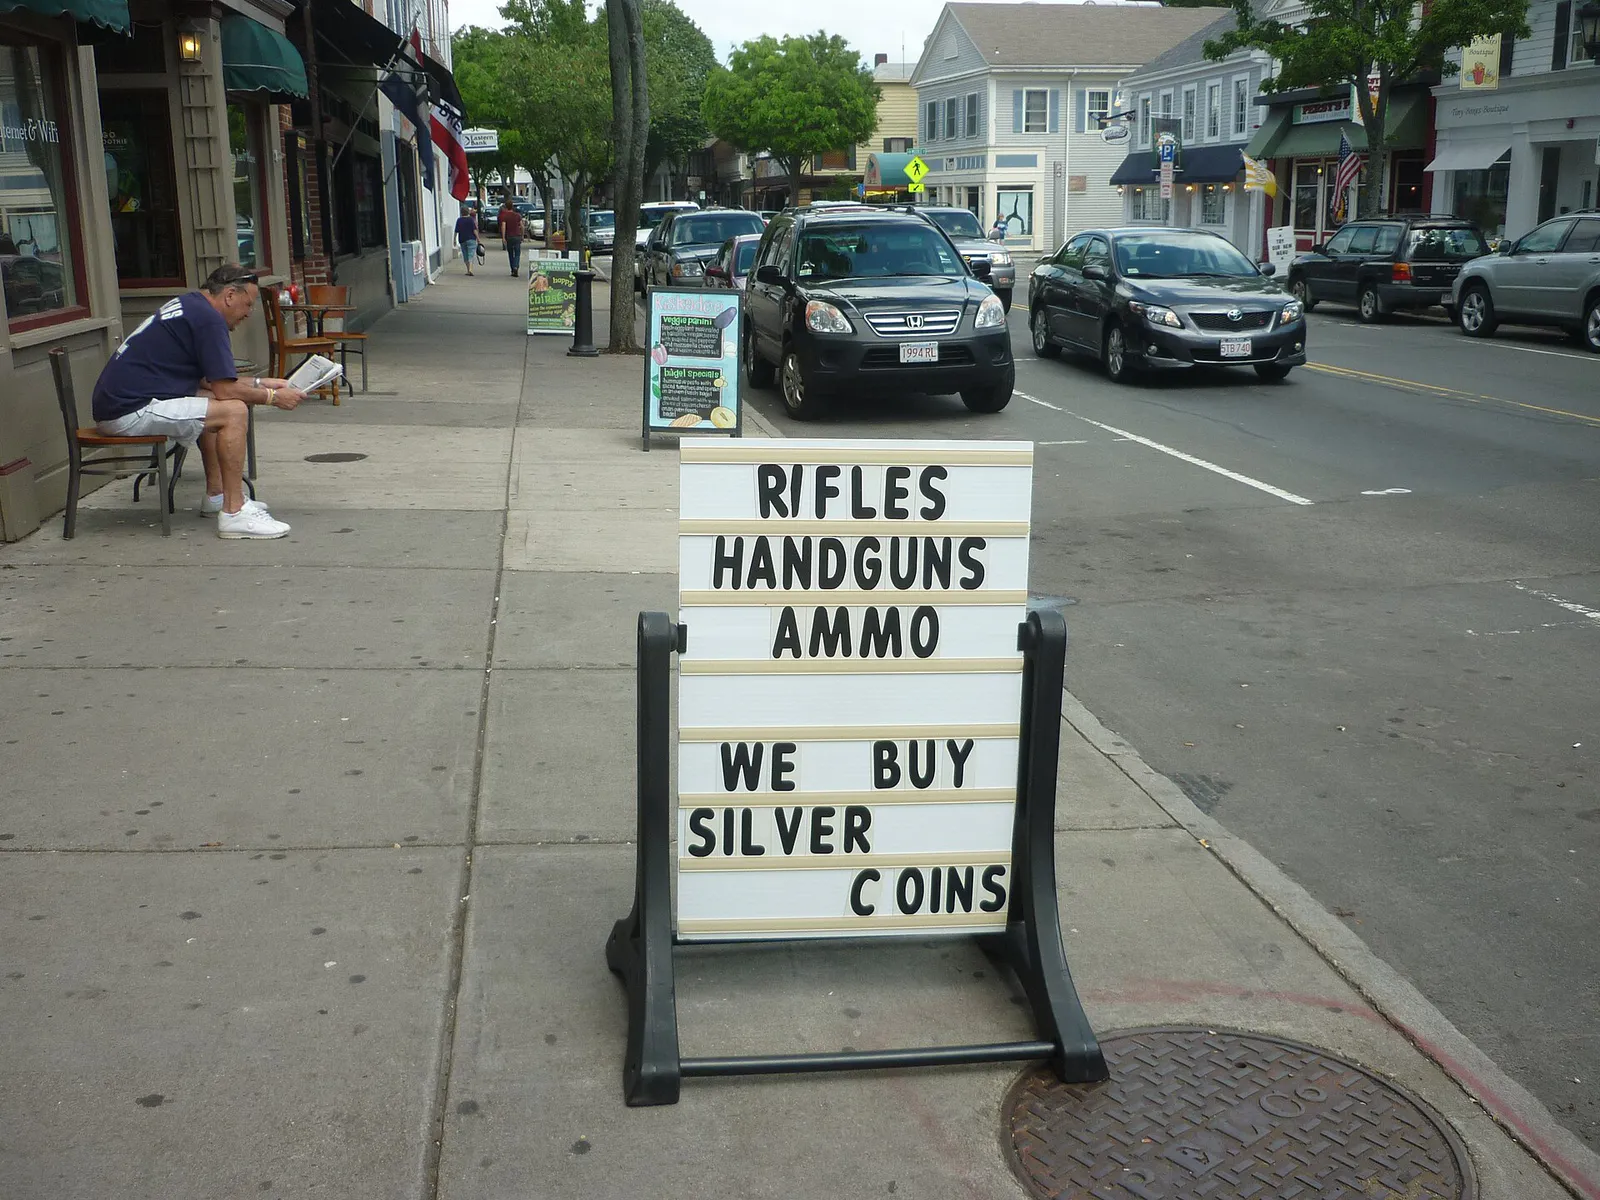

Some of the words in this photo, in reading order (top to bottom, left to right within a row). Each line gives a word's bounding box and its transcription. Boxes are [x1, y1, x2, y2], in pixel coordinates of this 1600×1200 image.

[1164, 145, 1171, 156] P
[663, 316, 687, 325] veggie
[688, 317, 713, 326] panini
[688, 370, 720, 379] specials
[902, 348, 923, 359] 1994
[925, 347, 936, 358] RL
[757, 463, 948, 521] RIFLES
[713, 535, 987, 591] HANDGUNS
[772, 605, 940, 659] AMMO
[720, 742, 797, 792] WE
[873, 738, 974, 790] BUY
[688, 805, 872, 858] SILVER
[850, 864, 1008, 916] COINS
